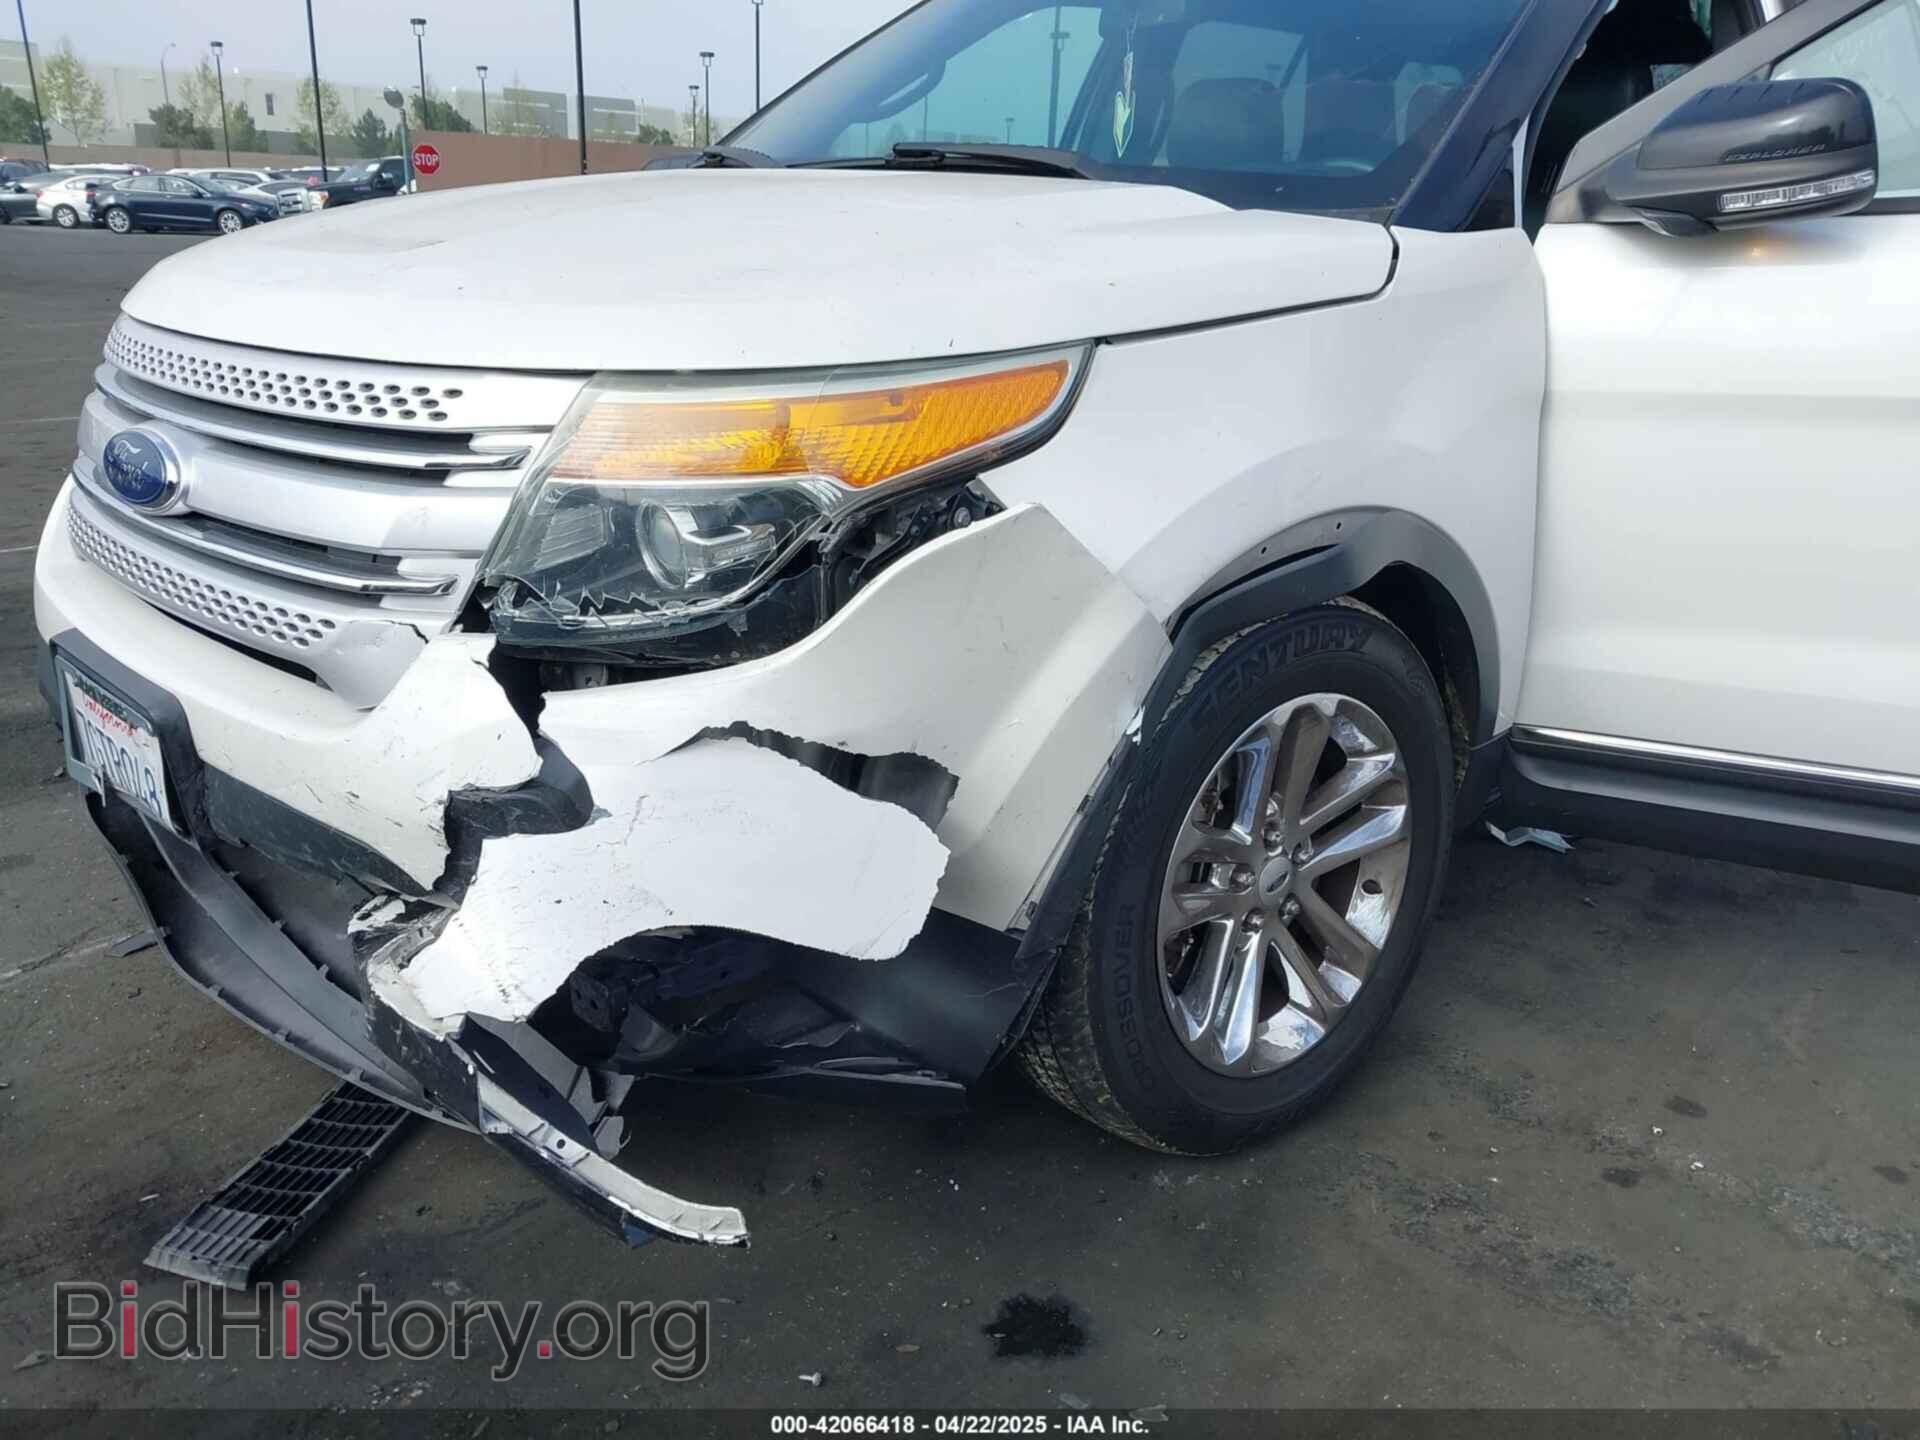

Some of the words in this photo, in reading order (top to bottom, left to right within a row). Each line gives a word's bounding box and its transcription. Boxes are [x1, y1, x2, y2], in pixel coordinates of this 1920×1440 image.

[415, 153, 439, 166] STOP
[1725, 144, 1826, 161] EXPLORER
[1190, 622, 1373, 730] CENTURY
[1112, 903, 1155, 1092] CROSSOVER
